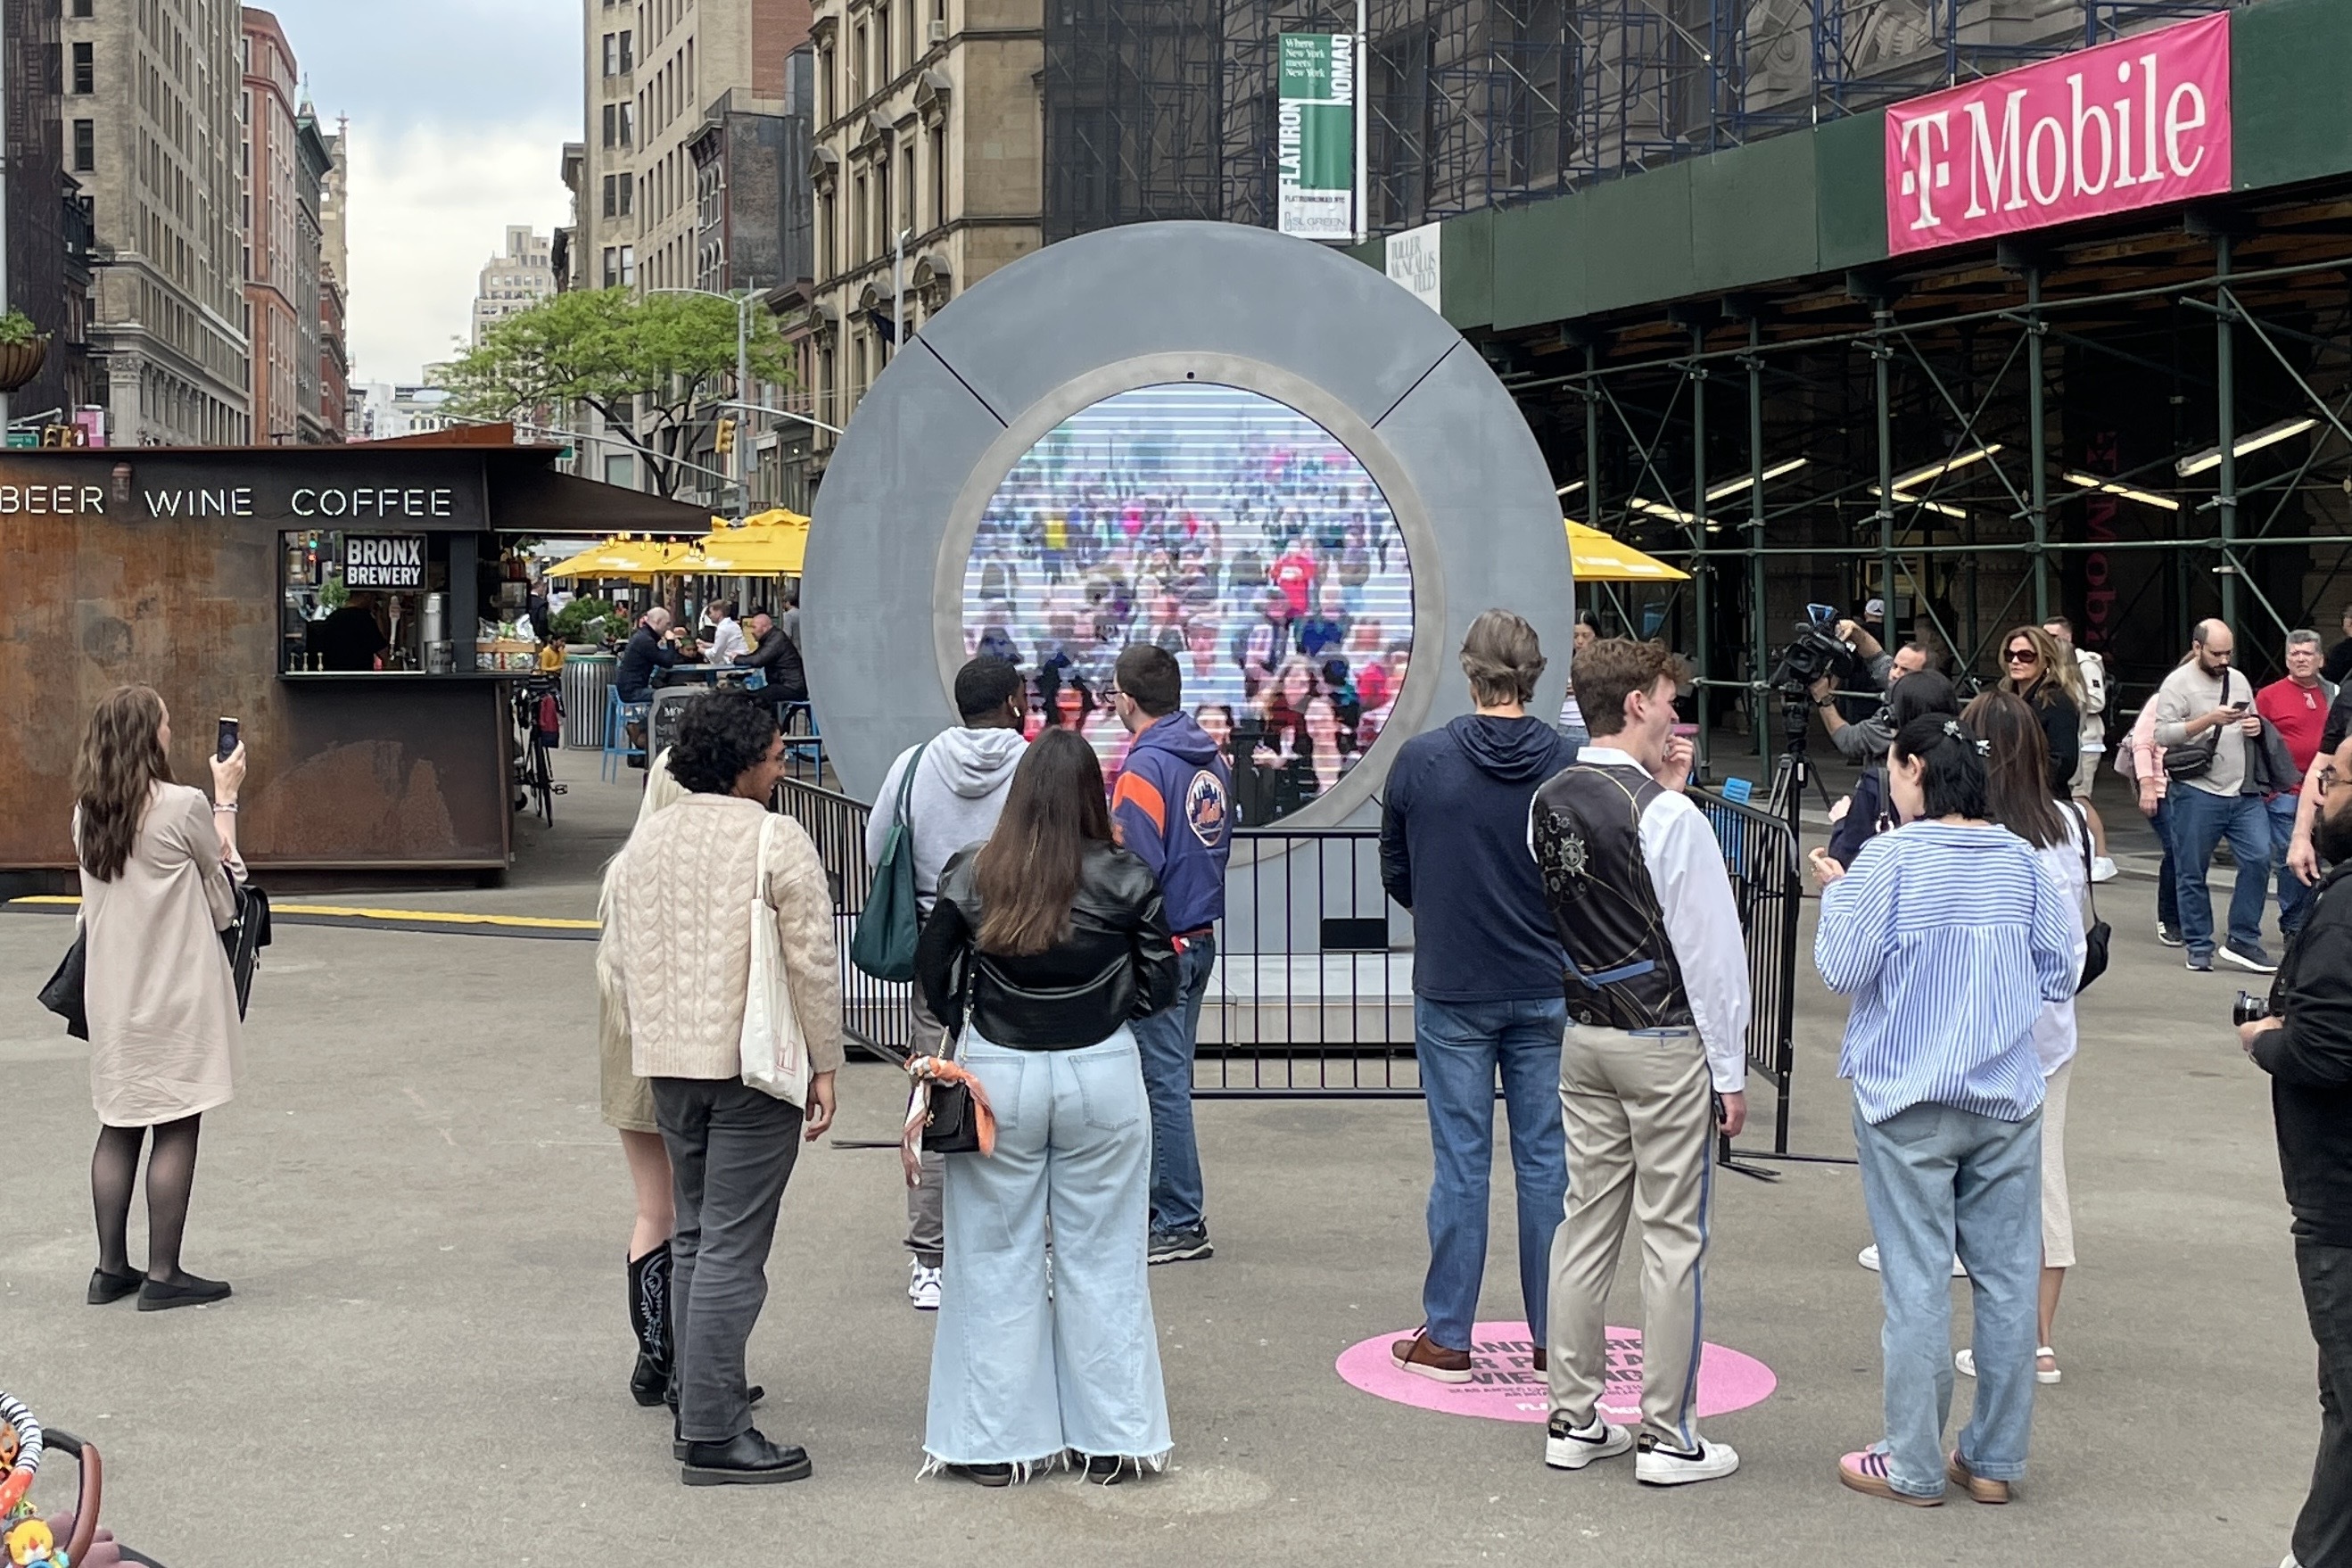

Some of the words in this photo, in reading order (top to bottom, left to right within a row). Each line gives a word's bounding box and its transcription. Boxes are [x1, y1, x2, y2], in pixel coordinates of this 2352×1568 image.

[1285, 37, 1315, 48] Where
[1285, 48, 1304, 58] New
[1285, 68, 1304, 78] New
[1331, 34, 1352, 105] NOMAD
[1278, 98, 1301, 186] FLATIRON
[0, 486, 103, 514] BEER
[144, 489, 252, 517] WINE
[291, 489, 451, 517] COFFEE
[347, 539, 421, 565] BRONX
[347, 566, 421, 585] BREWERY
